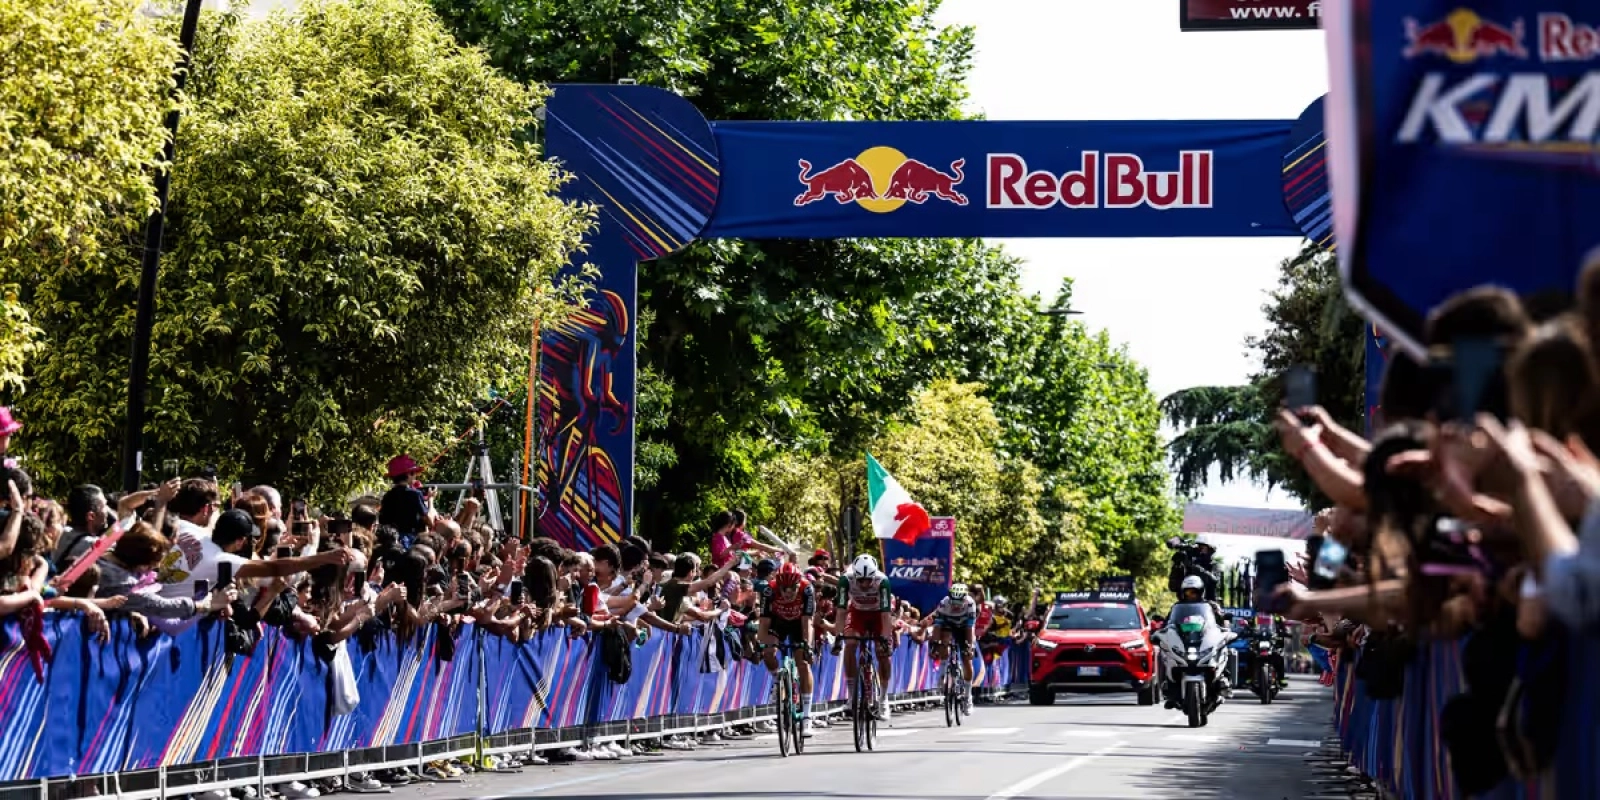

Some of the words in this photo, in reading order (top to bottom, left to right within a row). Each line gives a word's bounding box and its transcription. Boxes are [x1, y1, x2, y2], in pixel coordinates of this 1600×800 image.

[1229, 6, 1301, 19] www.
[1397, 72, 1600, 142] KM
[987, 151, 1099, 209] Red
[1104, 150, 1213, 210] Bull
[889, 567, 924, 577] KM
